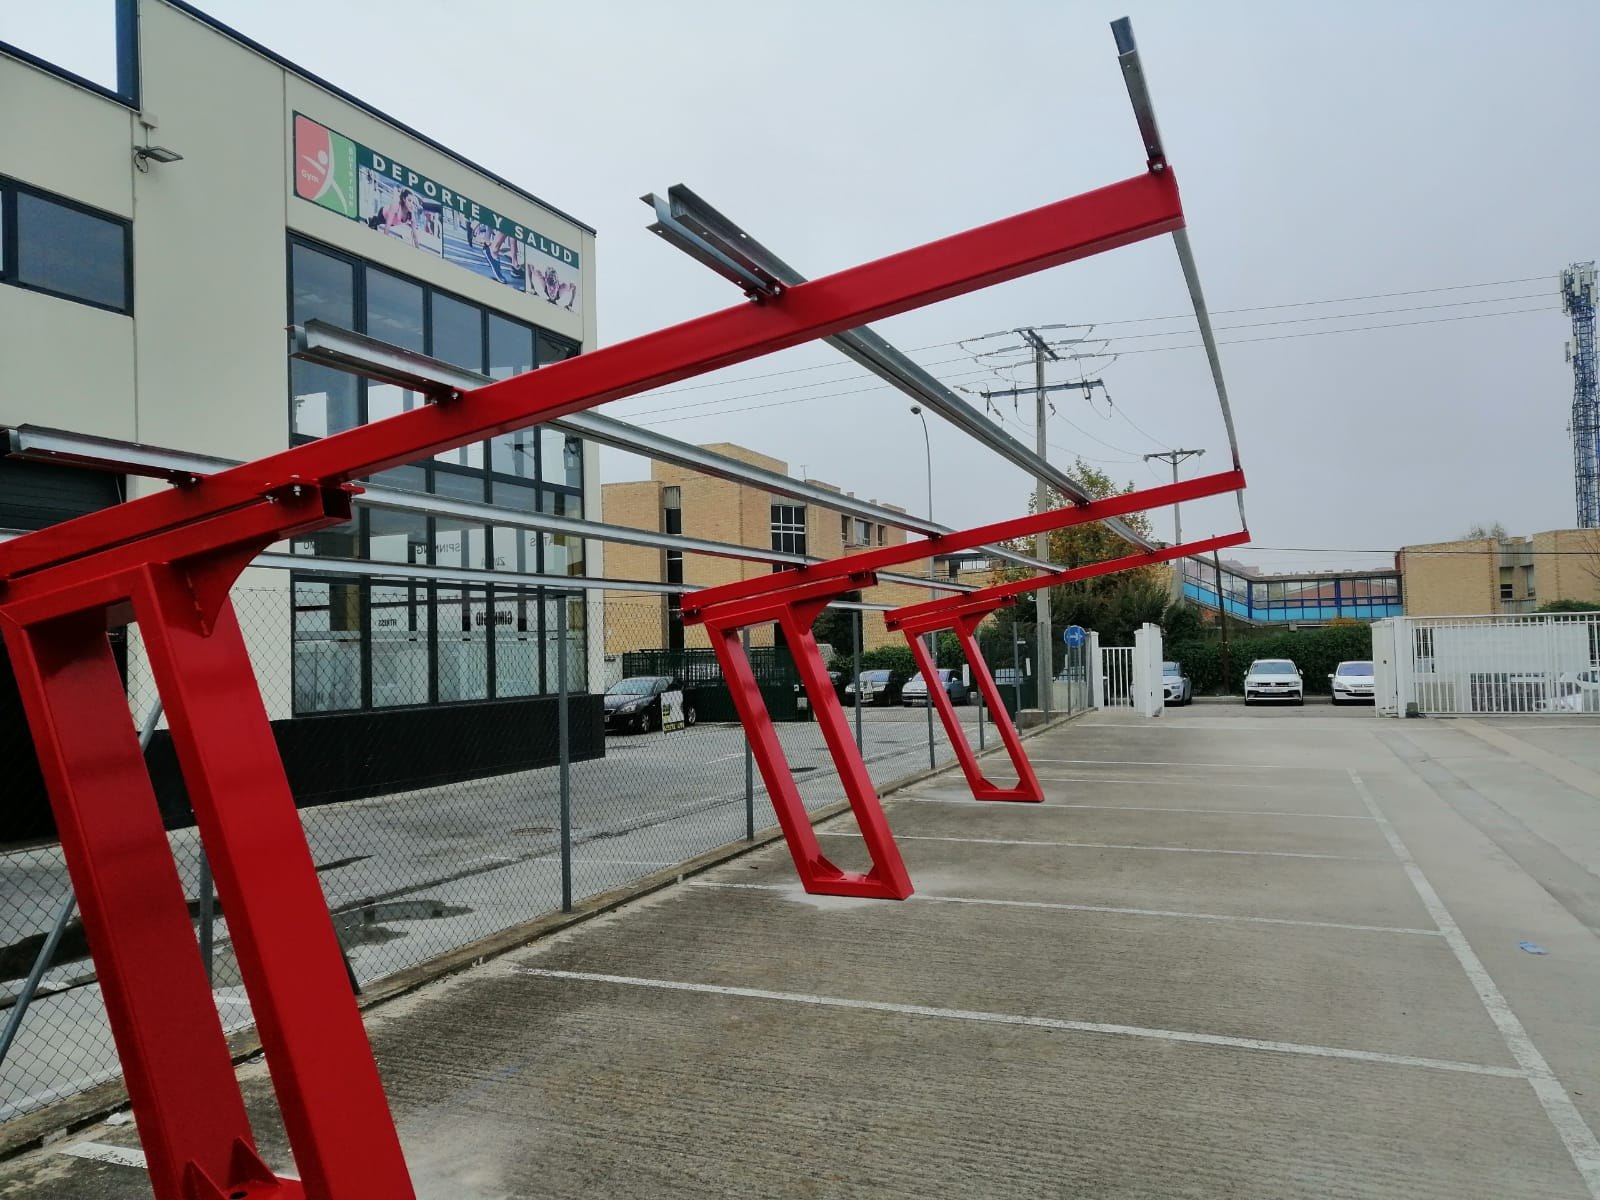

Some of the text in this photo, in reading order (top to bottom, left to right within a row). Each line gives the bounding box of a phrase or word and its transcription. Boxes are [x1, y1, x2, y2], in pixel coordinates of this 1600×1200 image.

[301, 168, 320, 183] Gym
[372, 153, 572, 263] DEPORTE Y SALUD
